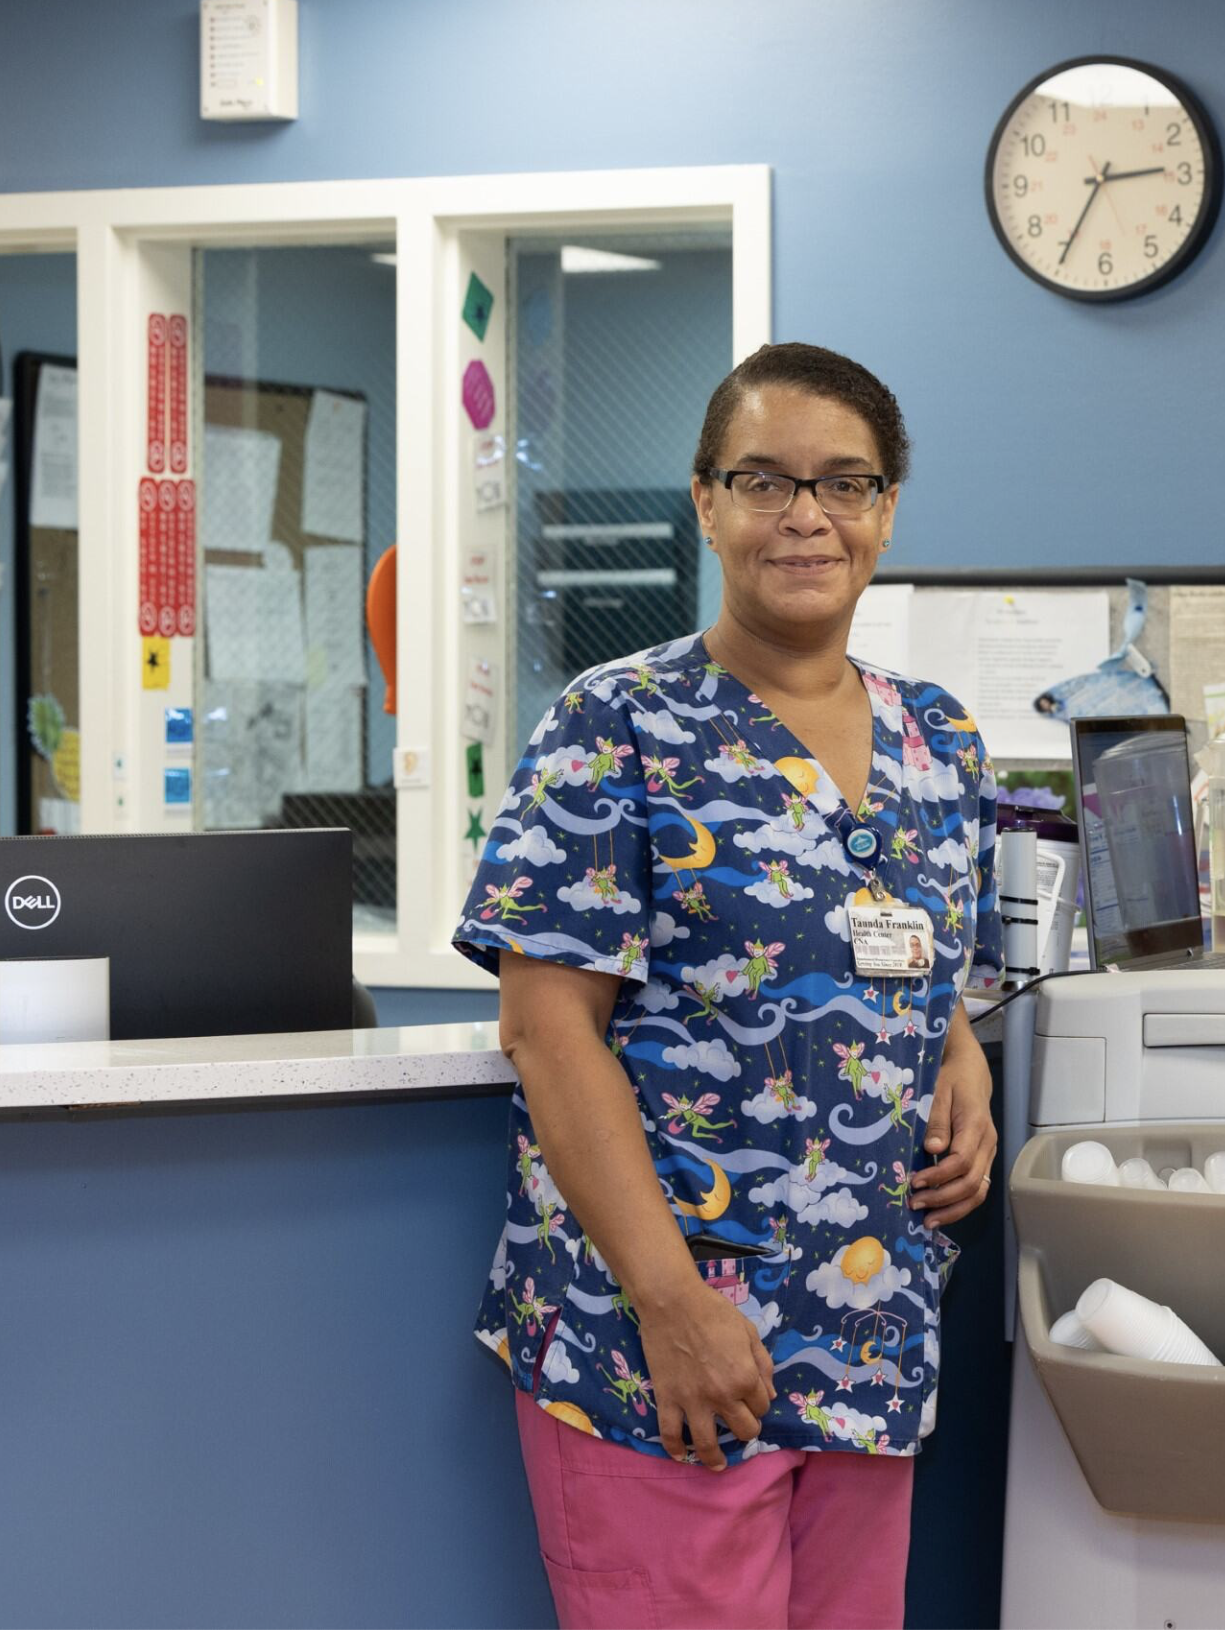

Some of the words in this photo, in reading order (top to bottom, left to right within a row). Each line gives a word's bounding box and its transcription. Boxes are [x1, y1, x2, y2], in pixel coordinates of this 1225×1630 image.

[1049, 101, 1070, 123] 11
[1021, 133, 1046, 158] 10
[1167, 123, 1181, 146] 2
[1176, 161, 1192, 186] 3
[1013, 175, 1028, 198] 9
[1027, 215, 1043, 238] 8
[1168, 205, 1183, 226] 4
[1143, 235, 1159, 258] 5
[1098, 252, 1113, 275] 6
[12, 895, 56, 910] DELL
[851, 917, 884, 929] Taunda
[885, 919, 924, 930] Franklin
[873, 930, 893, 938] Center
